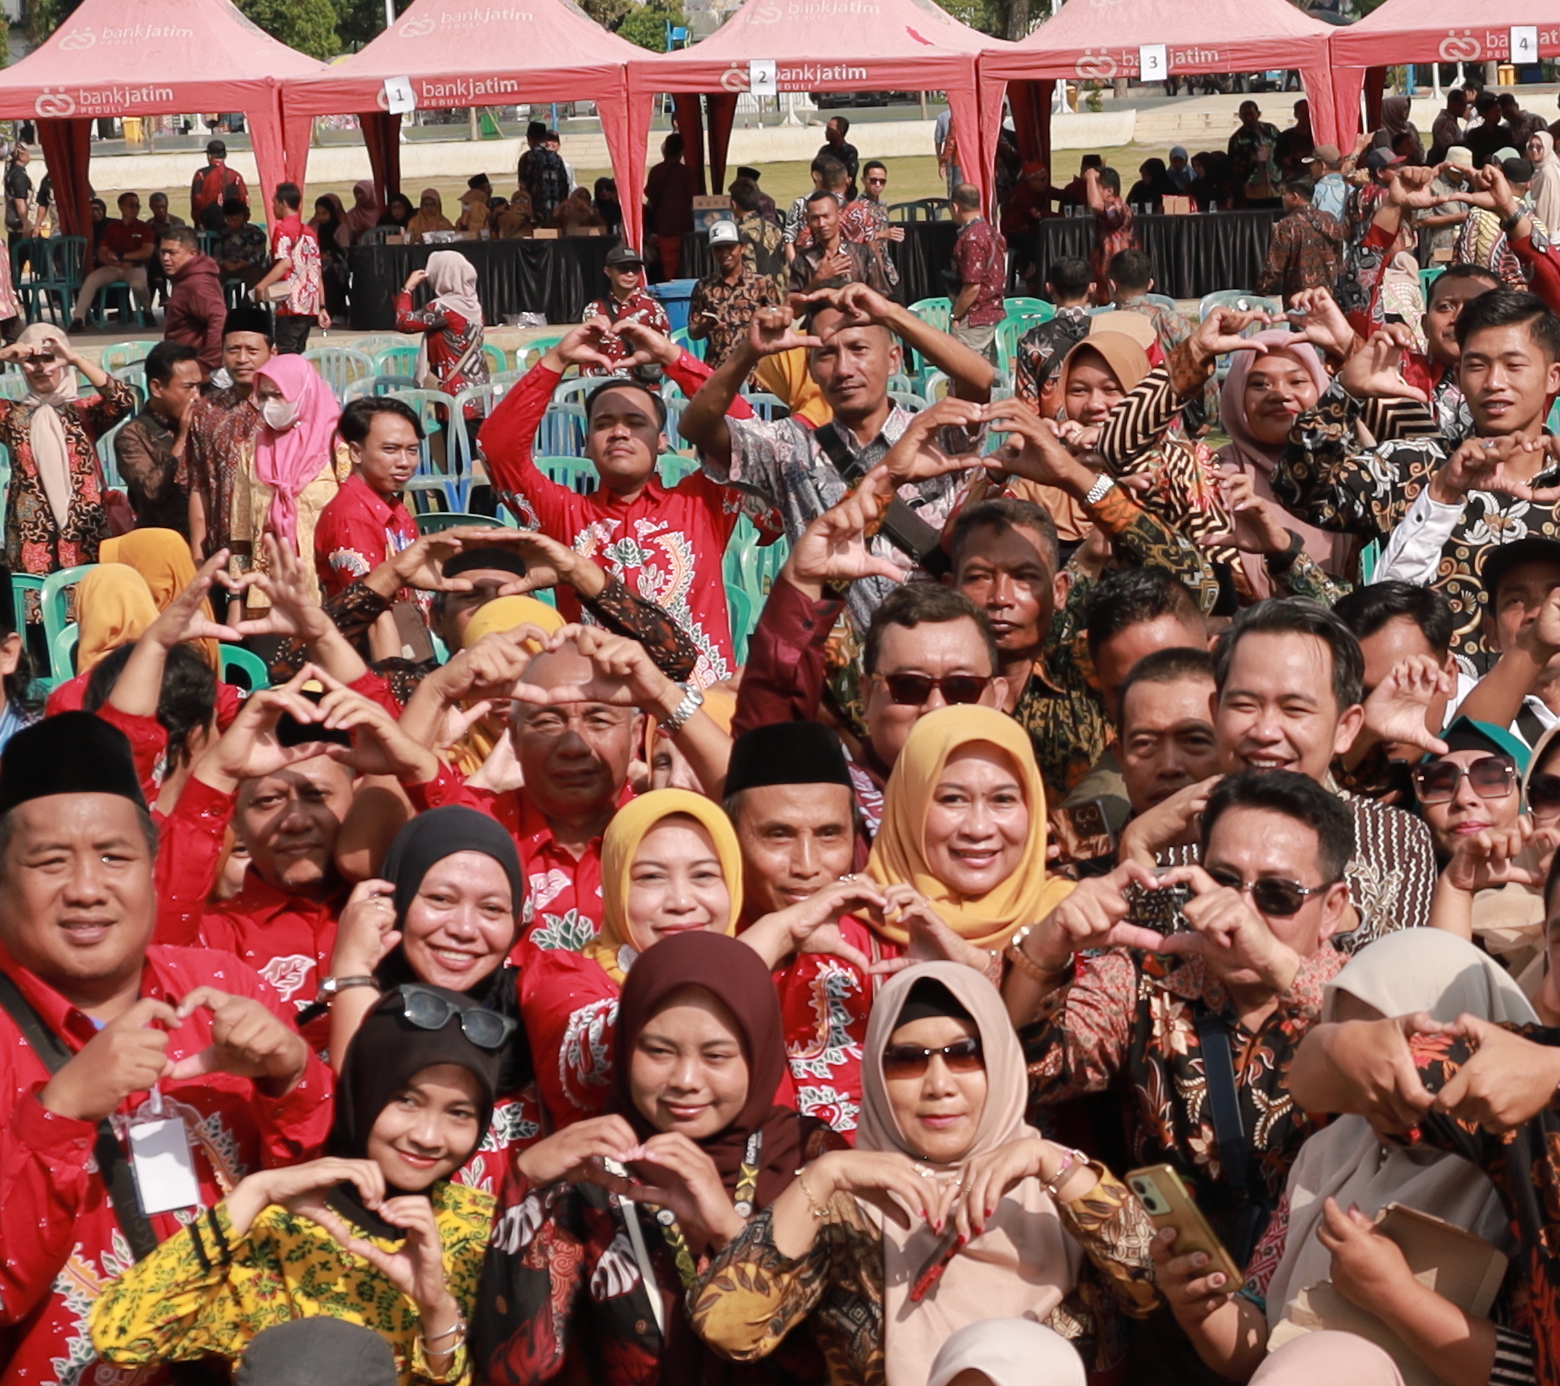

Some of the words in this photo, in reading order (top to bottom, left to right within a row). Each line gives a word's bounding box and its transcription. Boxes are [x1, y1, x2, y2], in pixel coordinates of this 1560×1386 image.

[441, 7, 534, 24] bankjatim
[788, 0, 880, 18] bankjatim
[101, 24, 194, 41] bankjatim
[1519, 38, 1529, 51] 4
[1122, 47, 1219, 68] bajatim
[1149, 56, 1158, 69] 3
[758, 70, 768, 84] 2
[395, 88, 405, 102] 1
[422, 77, 519, 99] bankjatim
[79, 85, 174, 107] bankjatim
[423, 98, 467, 107] PEDULI
[80, 105, 122, 115] PEDULI
